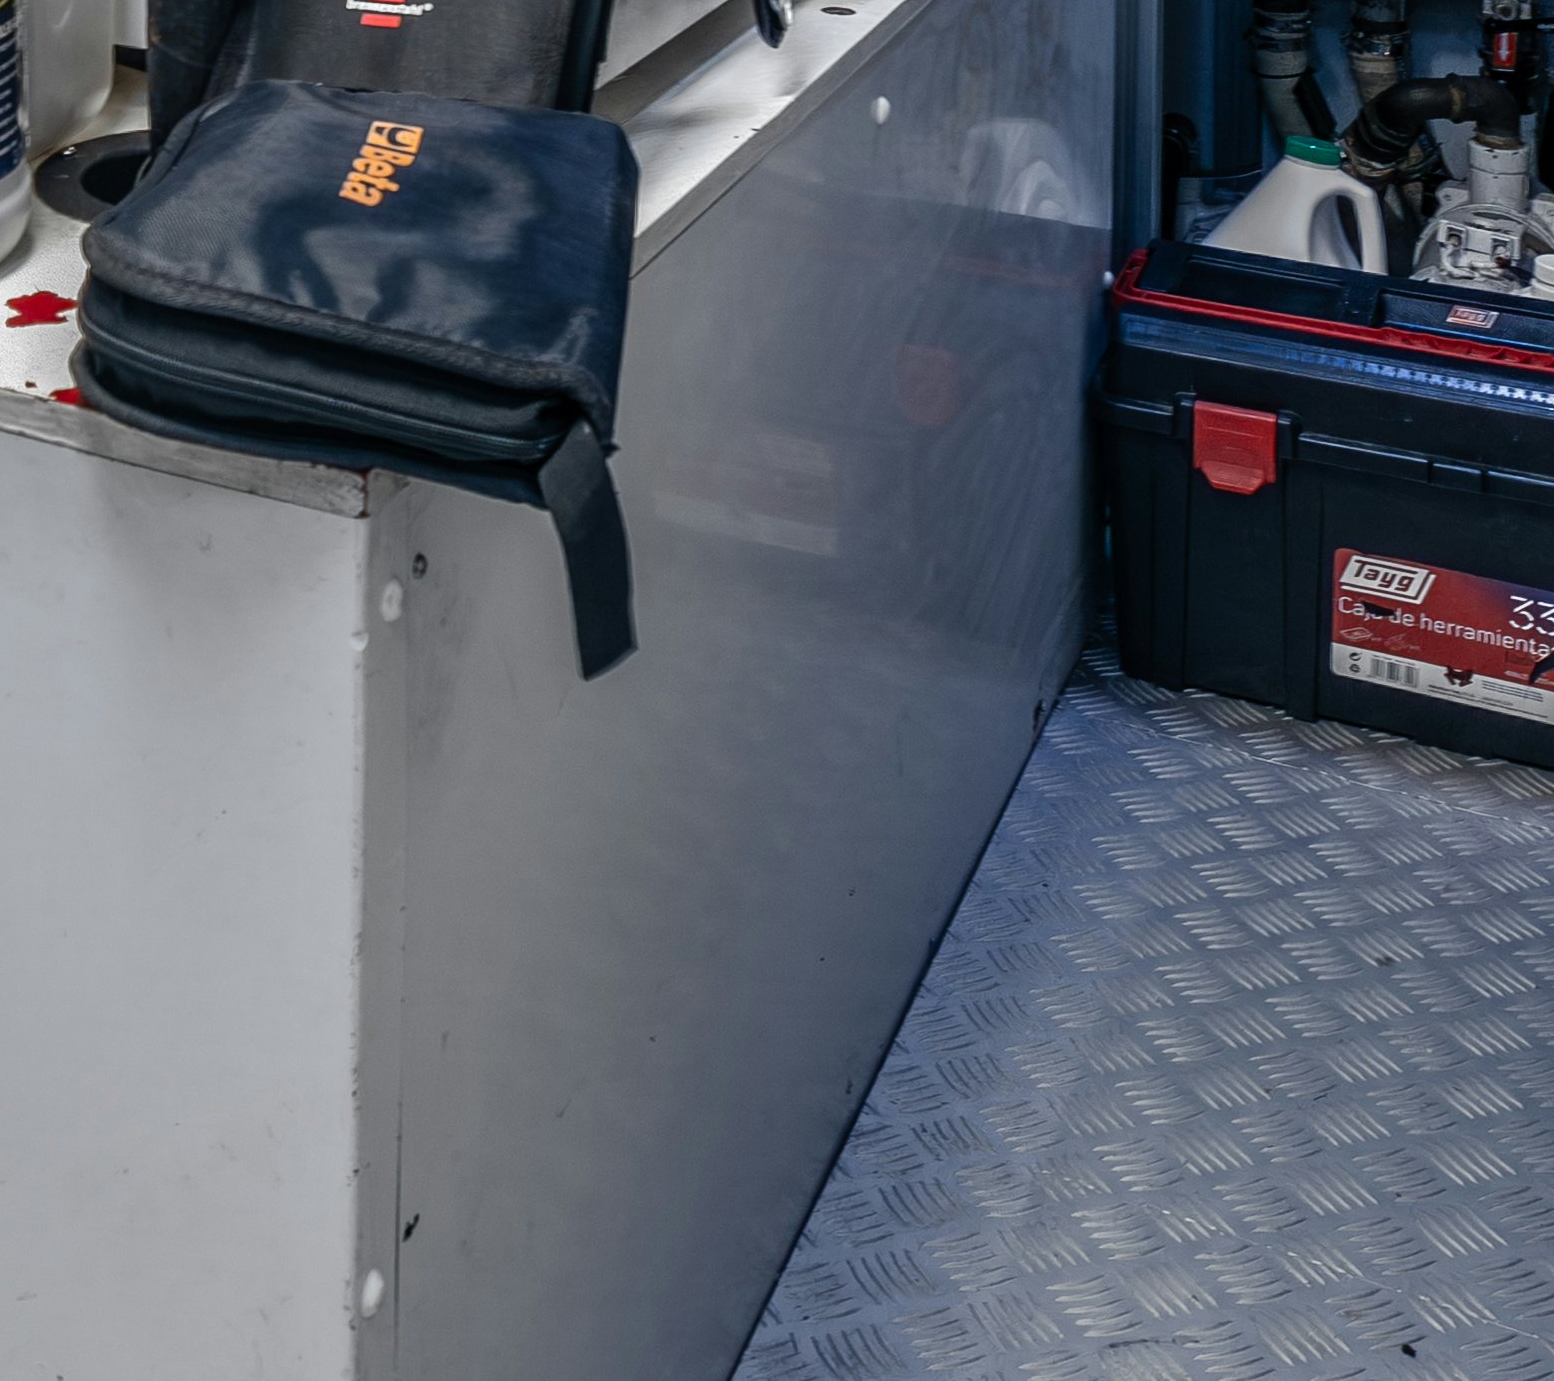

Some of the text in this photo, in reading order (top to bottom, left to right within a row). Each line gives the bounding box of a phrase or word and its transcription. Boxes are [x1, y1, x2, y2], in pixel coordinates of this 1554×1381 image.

[339, 144, 416, 208] Beta
[1353, 559, 1418, 593] Tayg
[1393, 608, 1415, 628] de
